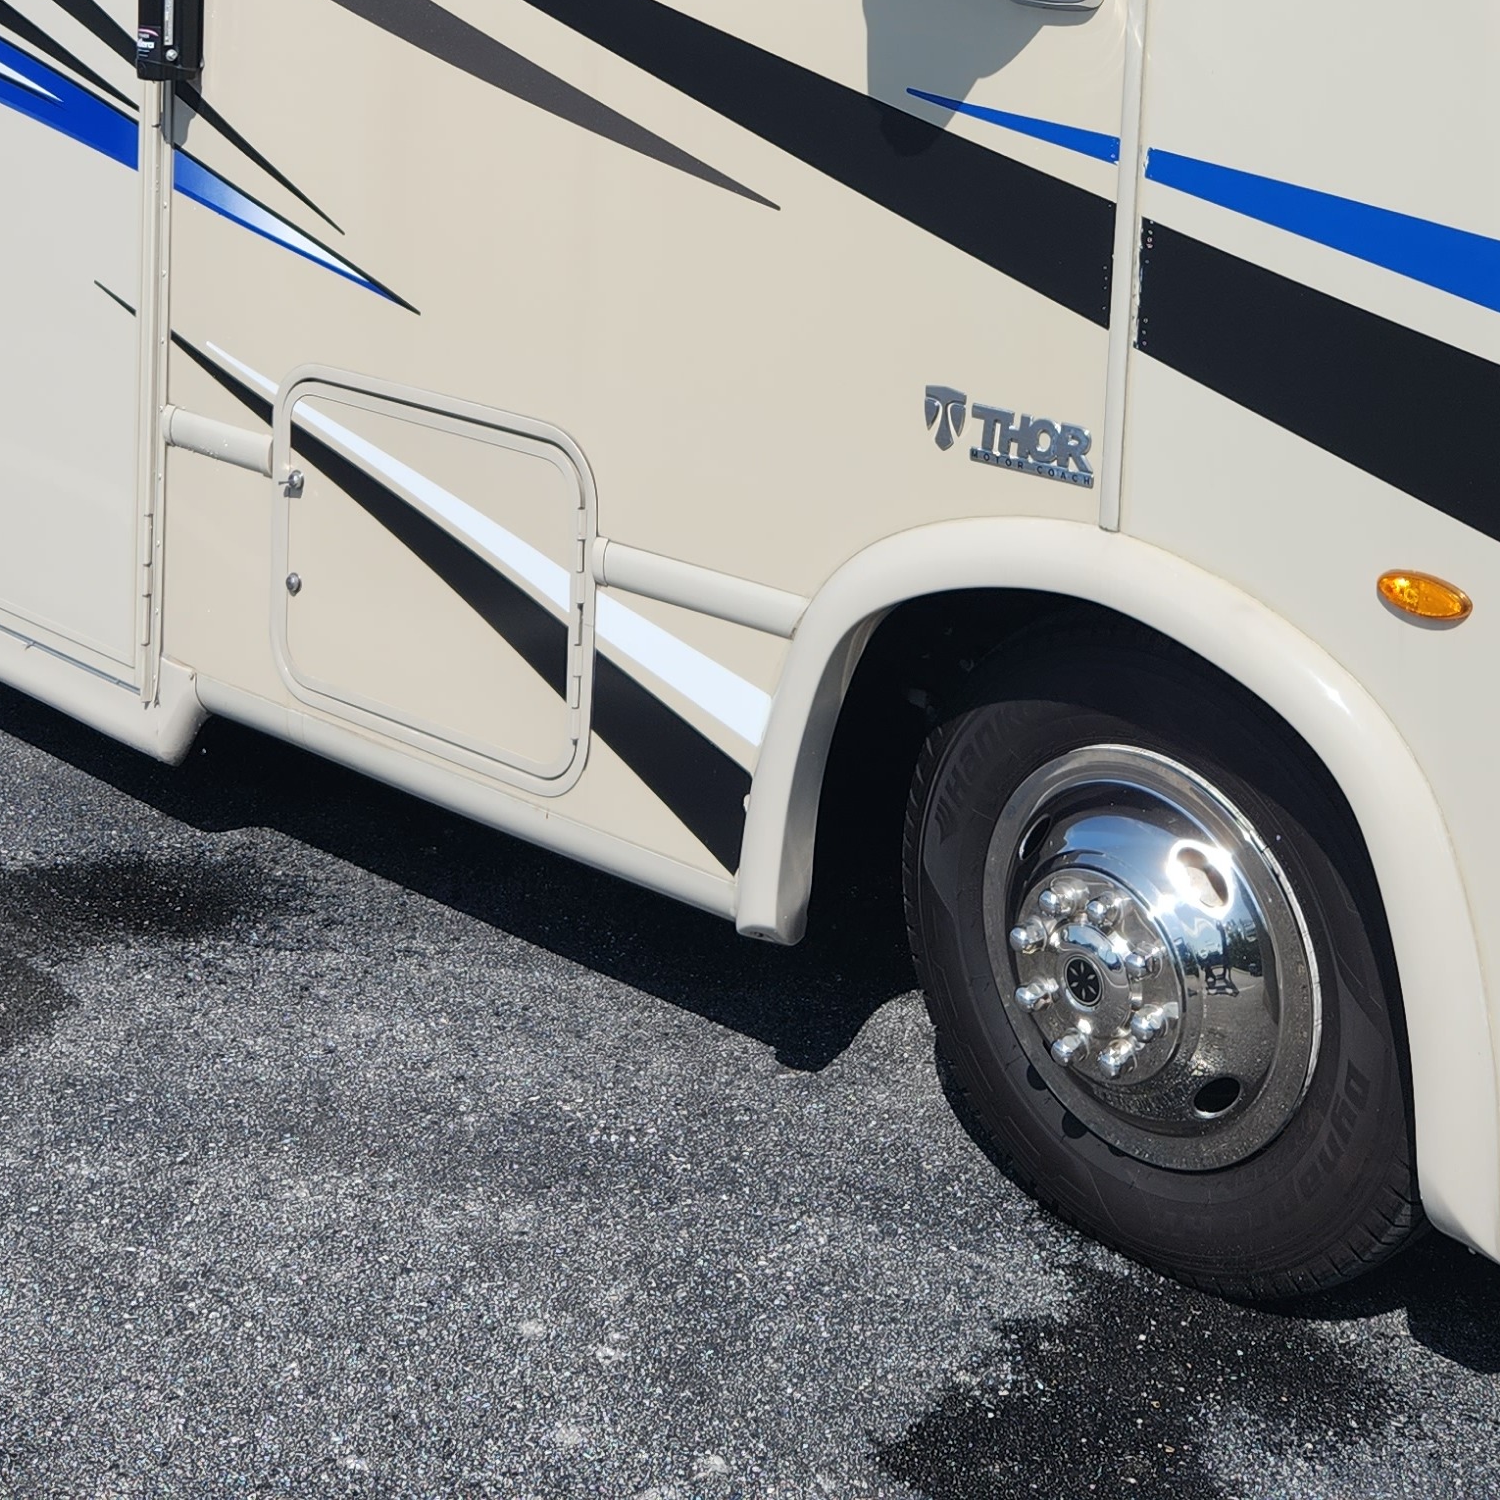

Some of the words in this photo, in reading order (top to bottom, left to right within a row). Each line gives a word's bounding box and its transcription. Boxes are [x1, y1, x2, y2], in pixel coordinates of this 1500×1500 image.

[972, 403, 1093, 473] THOR
[971, 451, 1023, 469] MOTOR
[1037, 466, 1090, 485] COACH
